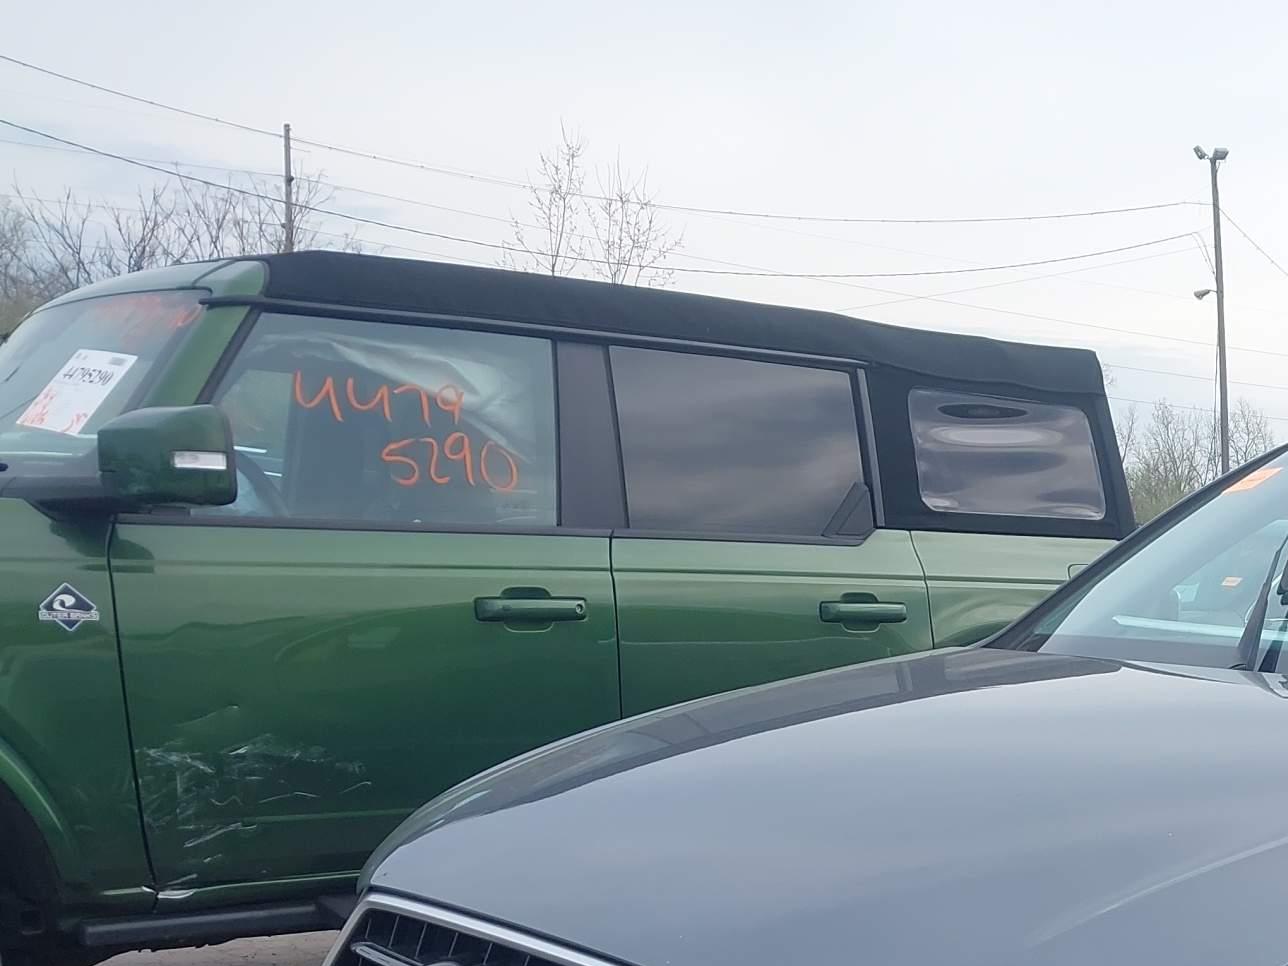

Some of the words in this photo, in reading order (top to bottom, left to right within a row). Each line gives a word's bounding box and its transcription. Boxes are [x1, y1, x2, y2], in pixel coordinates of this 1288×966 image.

[62, 366, 115, 386] 44795290
[295, 369, 464, 428] 4479
[381, 431, 518, 492] 5290
